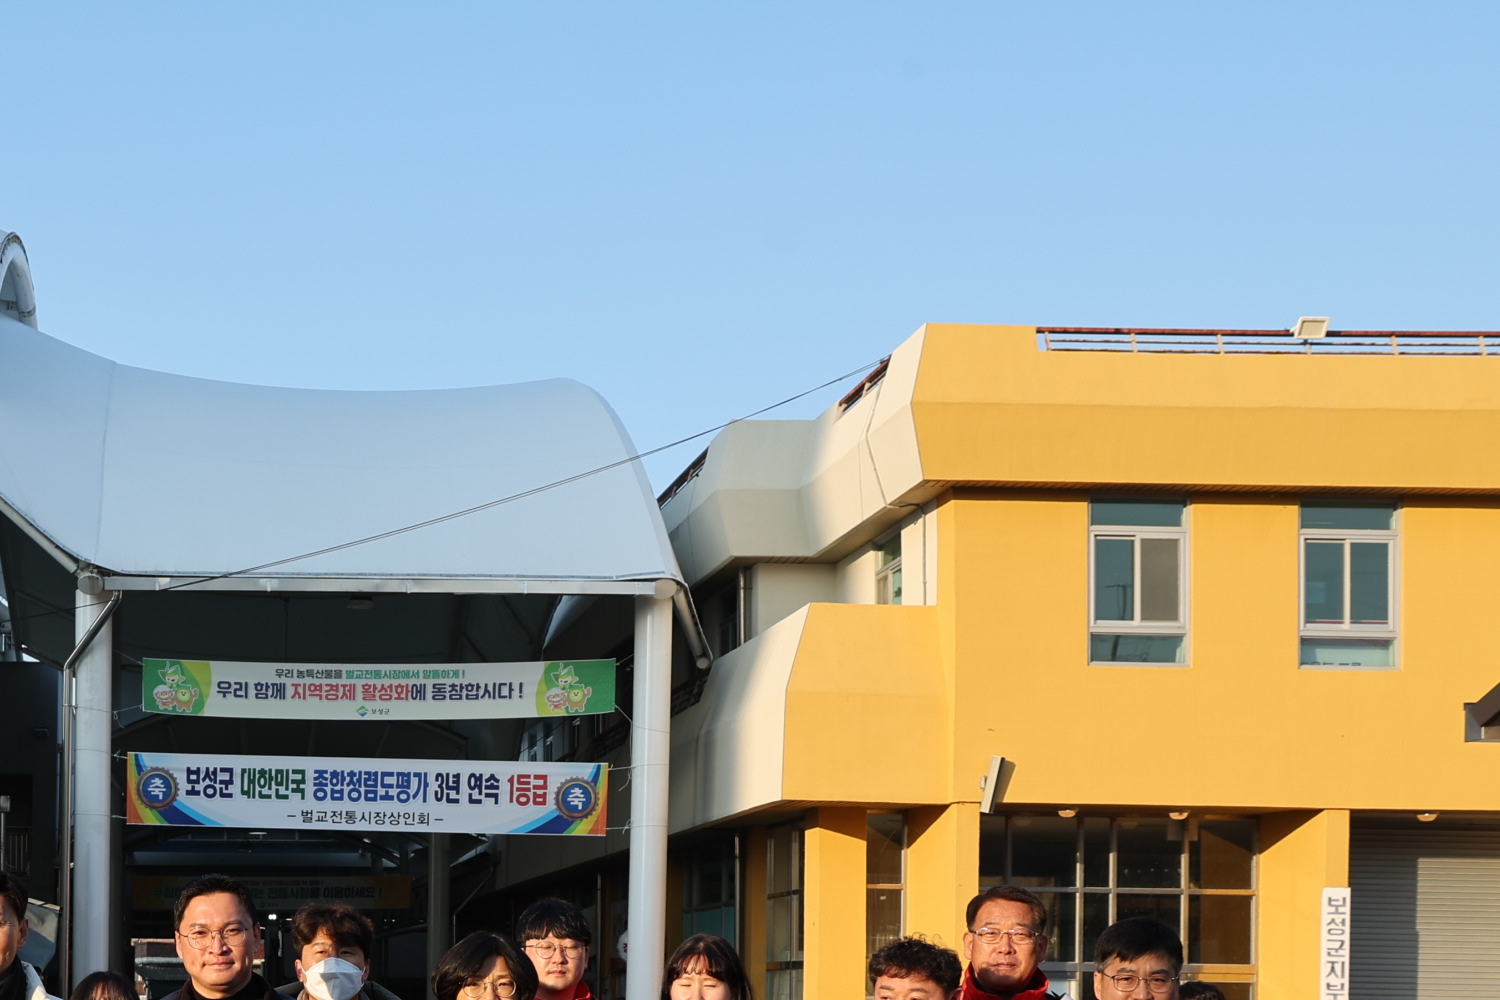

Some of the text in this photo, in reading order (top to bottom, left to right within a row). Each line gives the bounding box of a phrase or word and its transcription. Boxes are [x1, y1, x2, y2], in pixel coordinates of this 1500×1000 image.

[275, 668, 294, 679] 우리
[296, 668, 343, 680] 농특산물을
[345, 669, 420, 680] 벌교전통시장에서
[216, 680, 249, 699] 우리
[253, 681, 286, 701] 함께
[290, 682, 357, 701] 지역경제
[361, 682, 427, 702] 활성화에
[371, 708, 390, 716] 보성군
[147, 777, 167, 800] 축
[185, 766, 549, 807] 보성군 대한민국 종합청렴도평가 3년 연속 1등급
[567, 787, 587, 810] 축
[301, 809, 431, 826] 벌교전통시장상인회
[1325, 896, 1348, 1000] 보성군지부
